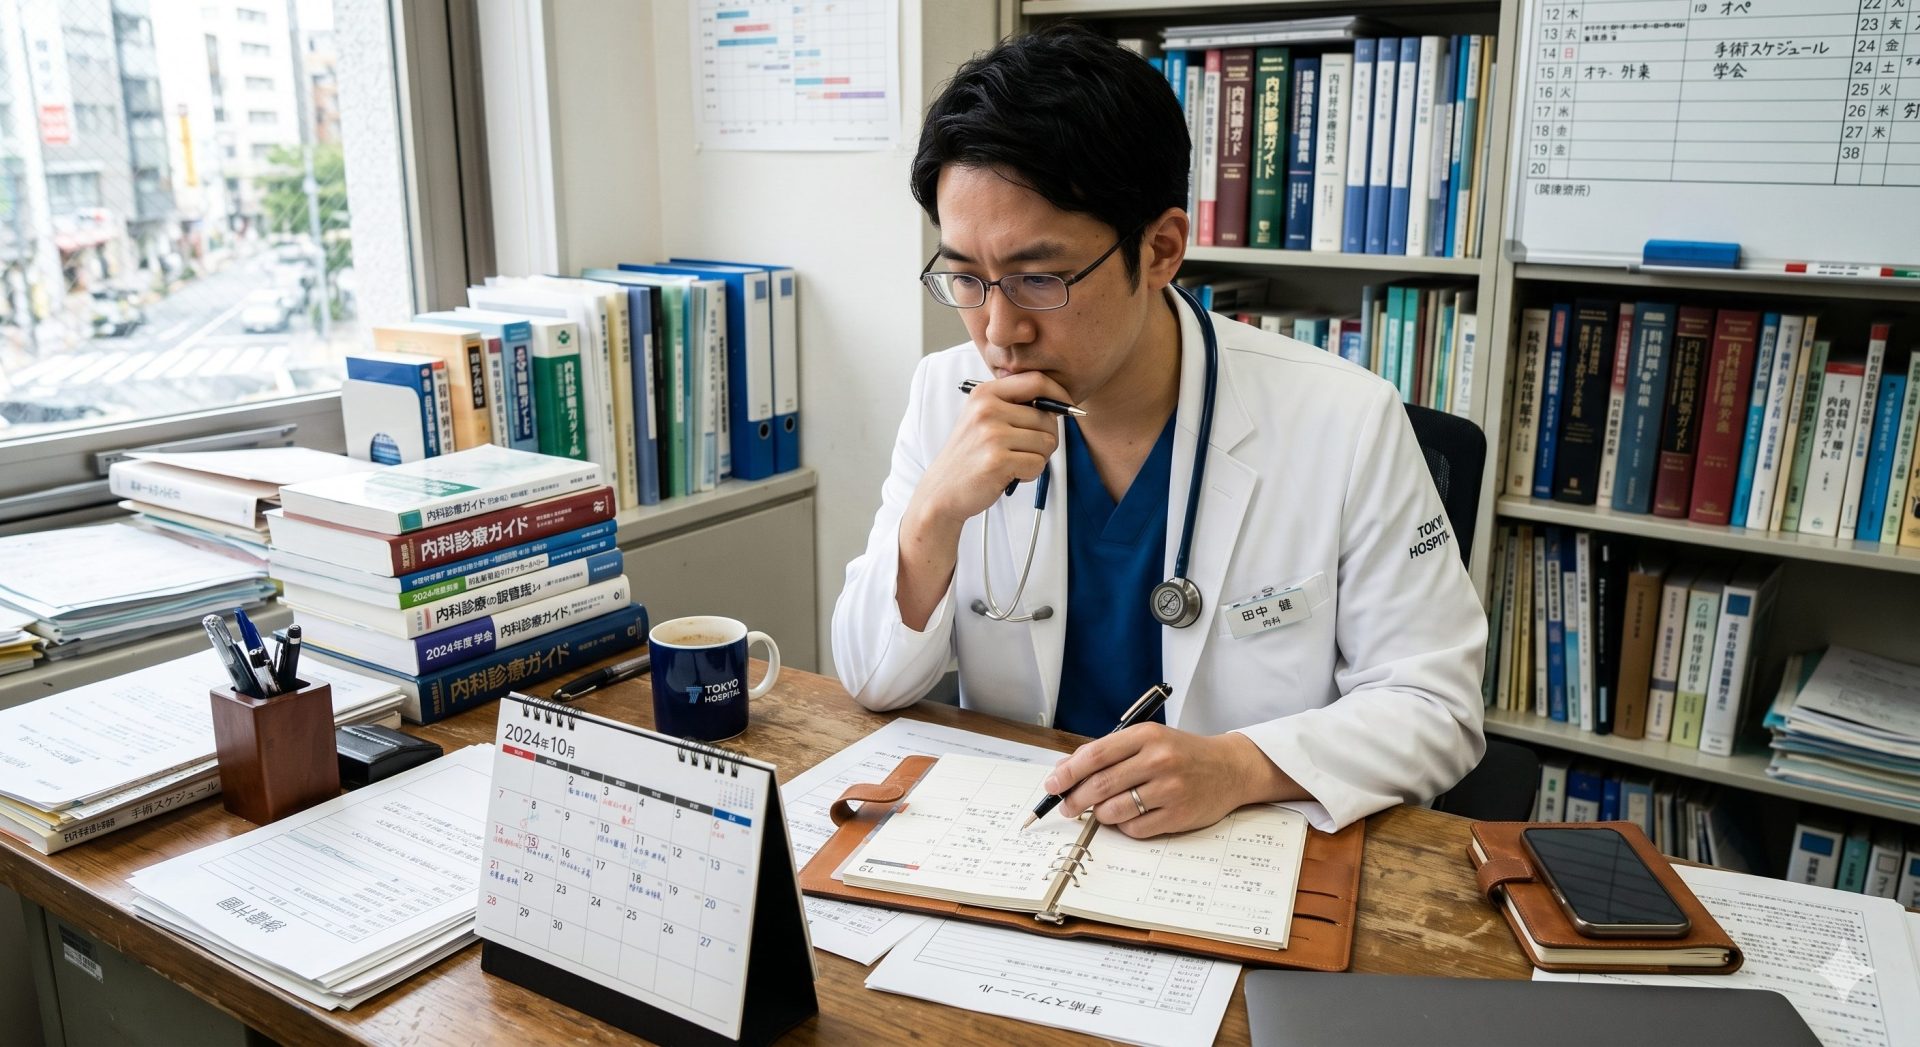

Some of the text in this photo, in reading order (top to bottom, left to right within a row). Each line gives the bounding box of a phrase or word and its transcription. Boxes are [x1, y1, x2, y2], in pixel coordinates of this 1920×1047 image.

[1546, 8, 1560, 20] 12
[1720, 1, 1751, 16] オペ
[1860, 18, 1879, 31] 23
[1544, 28, 1558, 40] 13
[1542, 48, 1574, 59] 14 日
[1714, 41, 1830, 58] 手術スケジュール
[1857, 39, 1899, 53] 24 金
[1540, 66, 1572, 79] 15 月
[1621, 64, 1650, 80] 外来
[1713, 62, 1747, 80] 学会
[1854, 61, 1872, 74] 24
[1881, 60, 1895, 73] 土
[1539, 87, 1553, 98] 16
[1851, 83, 1891, 96] 25 火
[1537, 106, 1551, 118] 17
[1848, 104, 1866, 117] 26
[1263, 76, 1280, 179] 内科診療ガイド
[1535, 125, 1549, 137] 18
[1845, 126, 1863, 139] 27
[1534, 144, 1547, 155] 19
[1842, 147, 1860, 159] 38
[1531, 163, 1546, 174] 20
[427, 498, 486, 522] 内科診療ガイド
[421, 516, 529, 562] 内科診療ガイド
[1409, 530, 1450, 559] HOSPIT
[1242, 598, 1293, 621] 田中 健
[501, 606, 570, 638] 内科診療ガイド
[1263, 616, 1281, 627] 内科
[426, 636, 472, 661] 2024年度
[452, 642, 570, 703] 内科診療ガイド
[705, 678, 739, 694] TOKYO
[704, 688, 741, 703] HOSPITAL
[505, 723, 576, 759] 2024年10月
[131, 782, 218, 819] 手術スケジュール
[568, 776, 574, 785] 2
[603, 787, 609, 796] 3
[639, 798, 645, 807] 4
[675, 809, 681, 819] 5
[713, 820, 720, 829] 6
[499, 790, 504, 798] 7
[531, 800, 537, 809] 8
[565, 812, 570, 821] 9
[600, 823, 610, 833] 10
[636, 834, 645, 845] 11
[672, 847, 682, 858] 12
[710, 859, 720, 871] 13
[495, 825, 504, 835] 14
[527, 836, 536, 847] 15
[561, 848, 570, 859] 16
[596, 860, 606, 871] 17
[632, 872, 642, 884] 18
[669, 885, 679, 896] 19
[705, 898, 716, 909] 20
[490, 860, 499, 870] 21
[523, 872, 533, 883] 22
[556, 884, 567, 895] 23
[591, 896, 601, 907] 24
[626, 909, 637, 921] 25
[663, 923, 674, 934] 26
[700, 936, 711, 948] 27
[487, 895, 563, 930] 28 29 30
